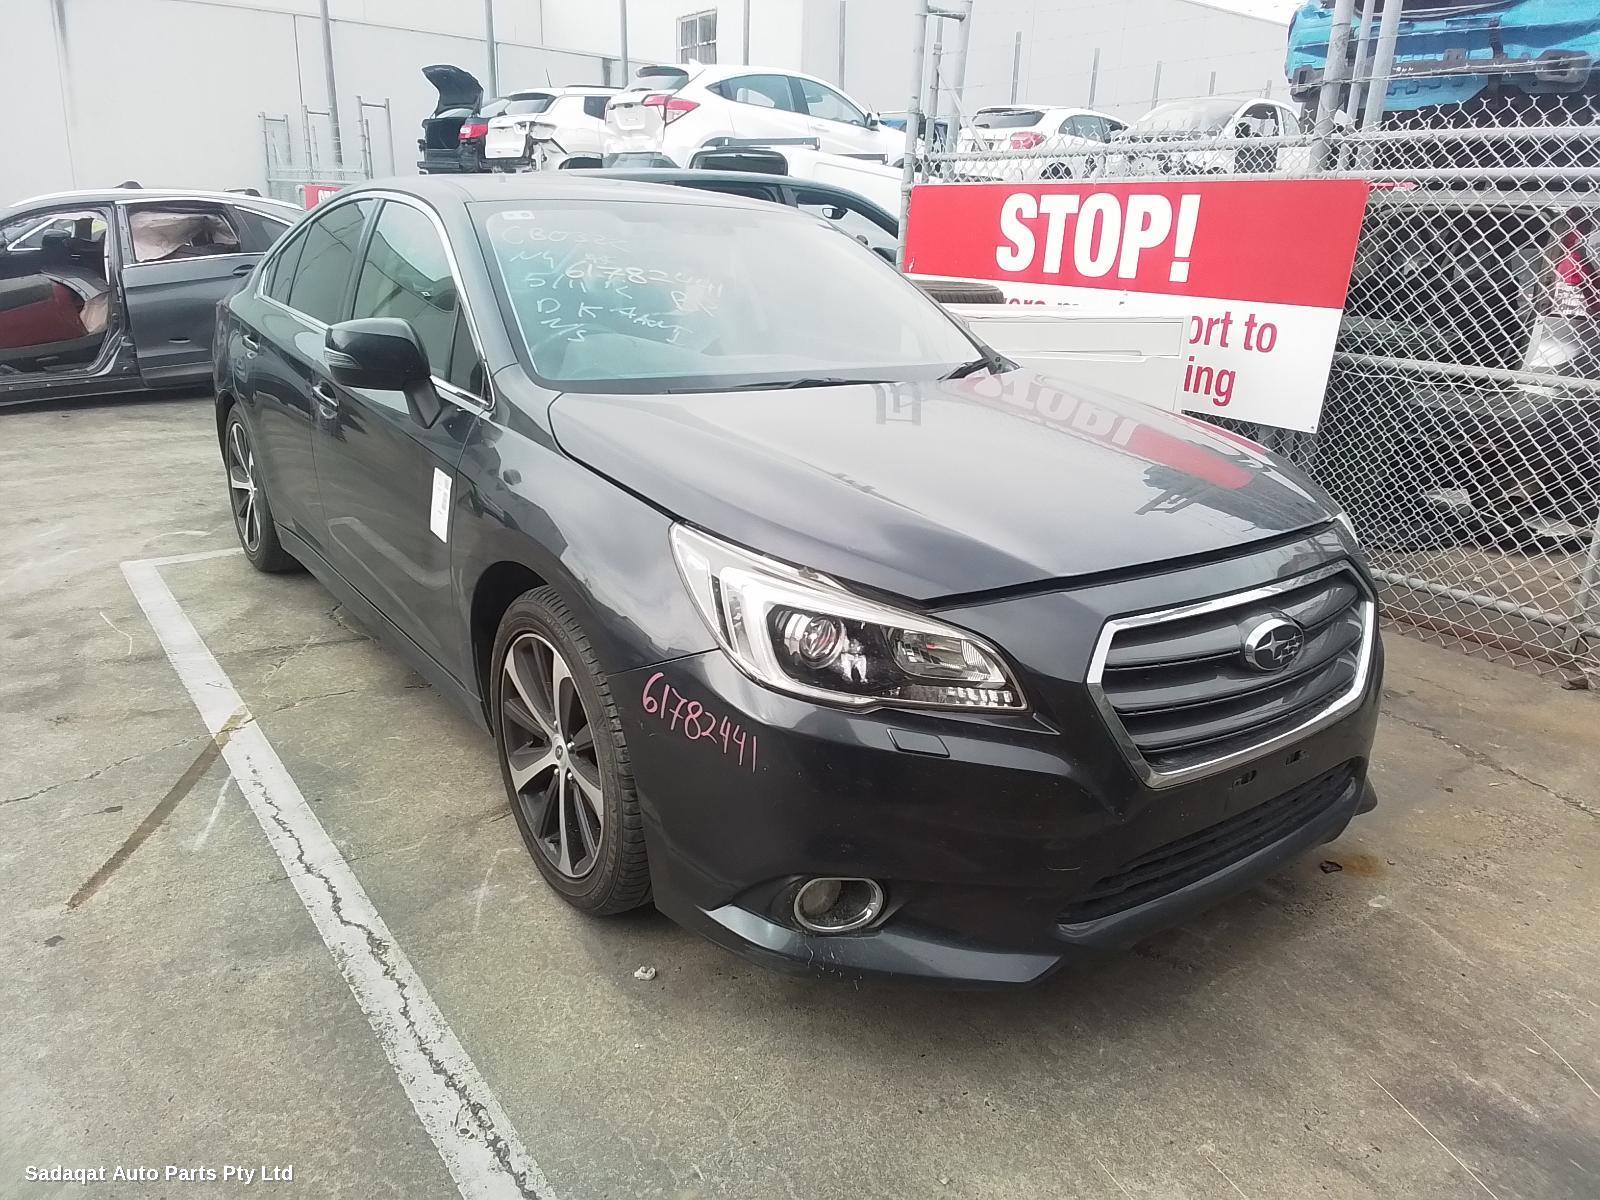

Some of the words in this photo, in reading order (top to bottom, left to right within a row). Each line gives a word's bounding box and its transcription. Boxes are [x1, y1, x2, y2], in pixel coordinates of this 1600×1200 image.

[995, 192, 1201, 283] STOP!
[1243, 314, 1278, 353] to
[1183, 356, 1236, 407] ing
[642, 671, 757, 773] 61782441
